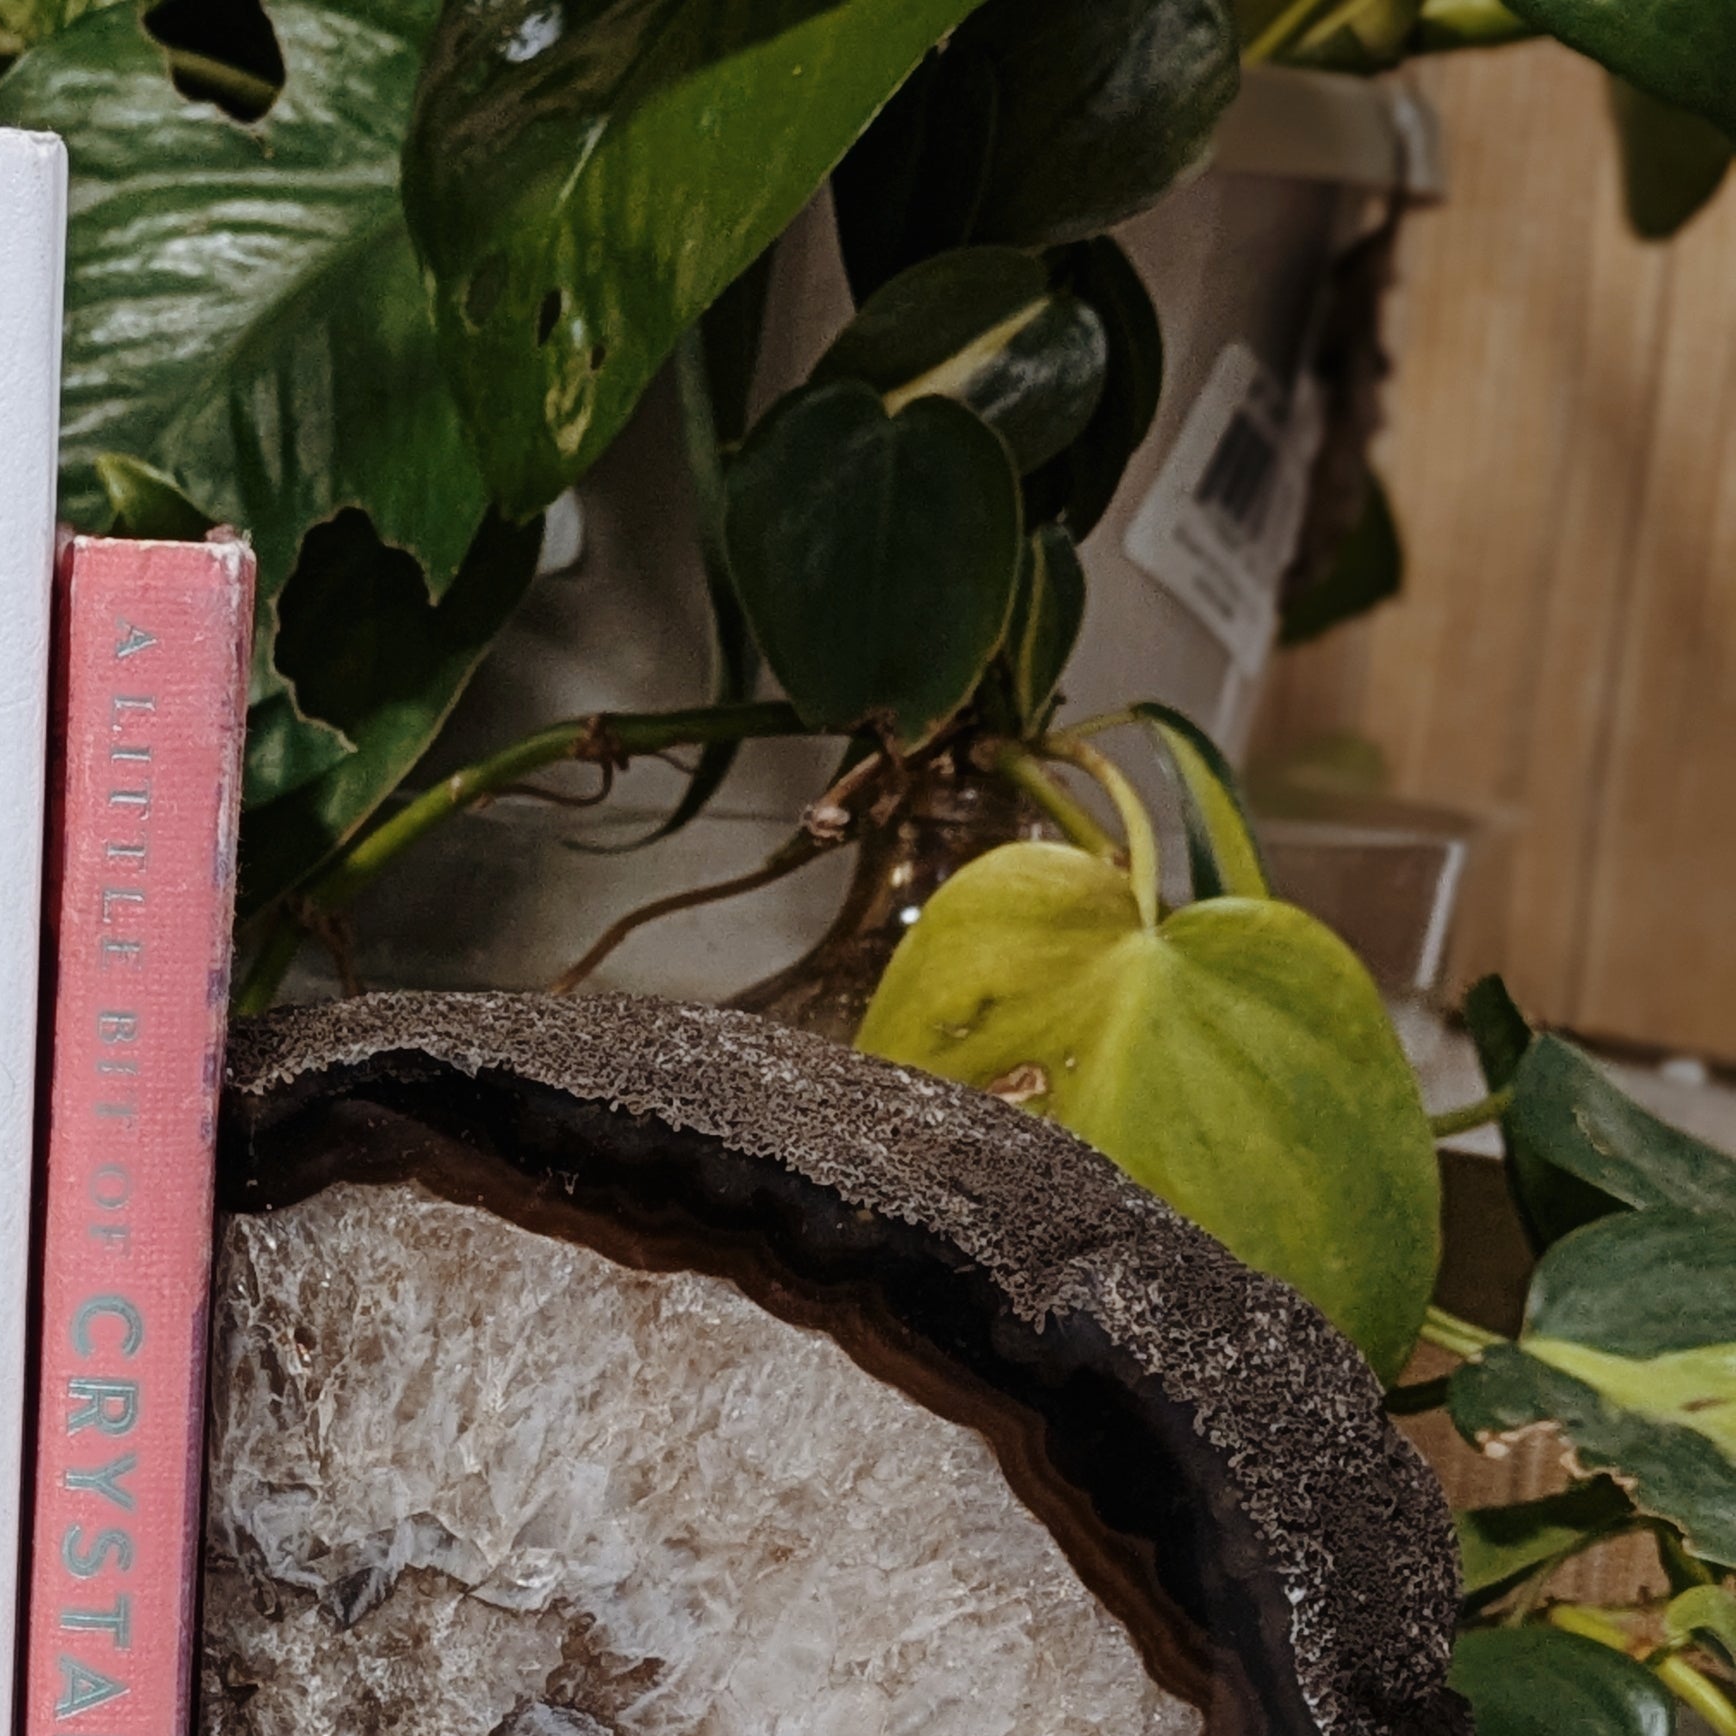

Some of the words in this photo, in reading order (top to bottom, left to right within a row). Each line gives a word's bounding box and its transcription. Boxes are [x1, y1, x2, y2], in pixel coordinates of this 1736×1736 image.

[114, 620, 158, 658] A
[100, 696, 156, 972] LITTLE
[96, 1010, 139, 1131] BIT
[89, 1164, 130, 1258] OF
